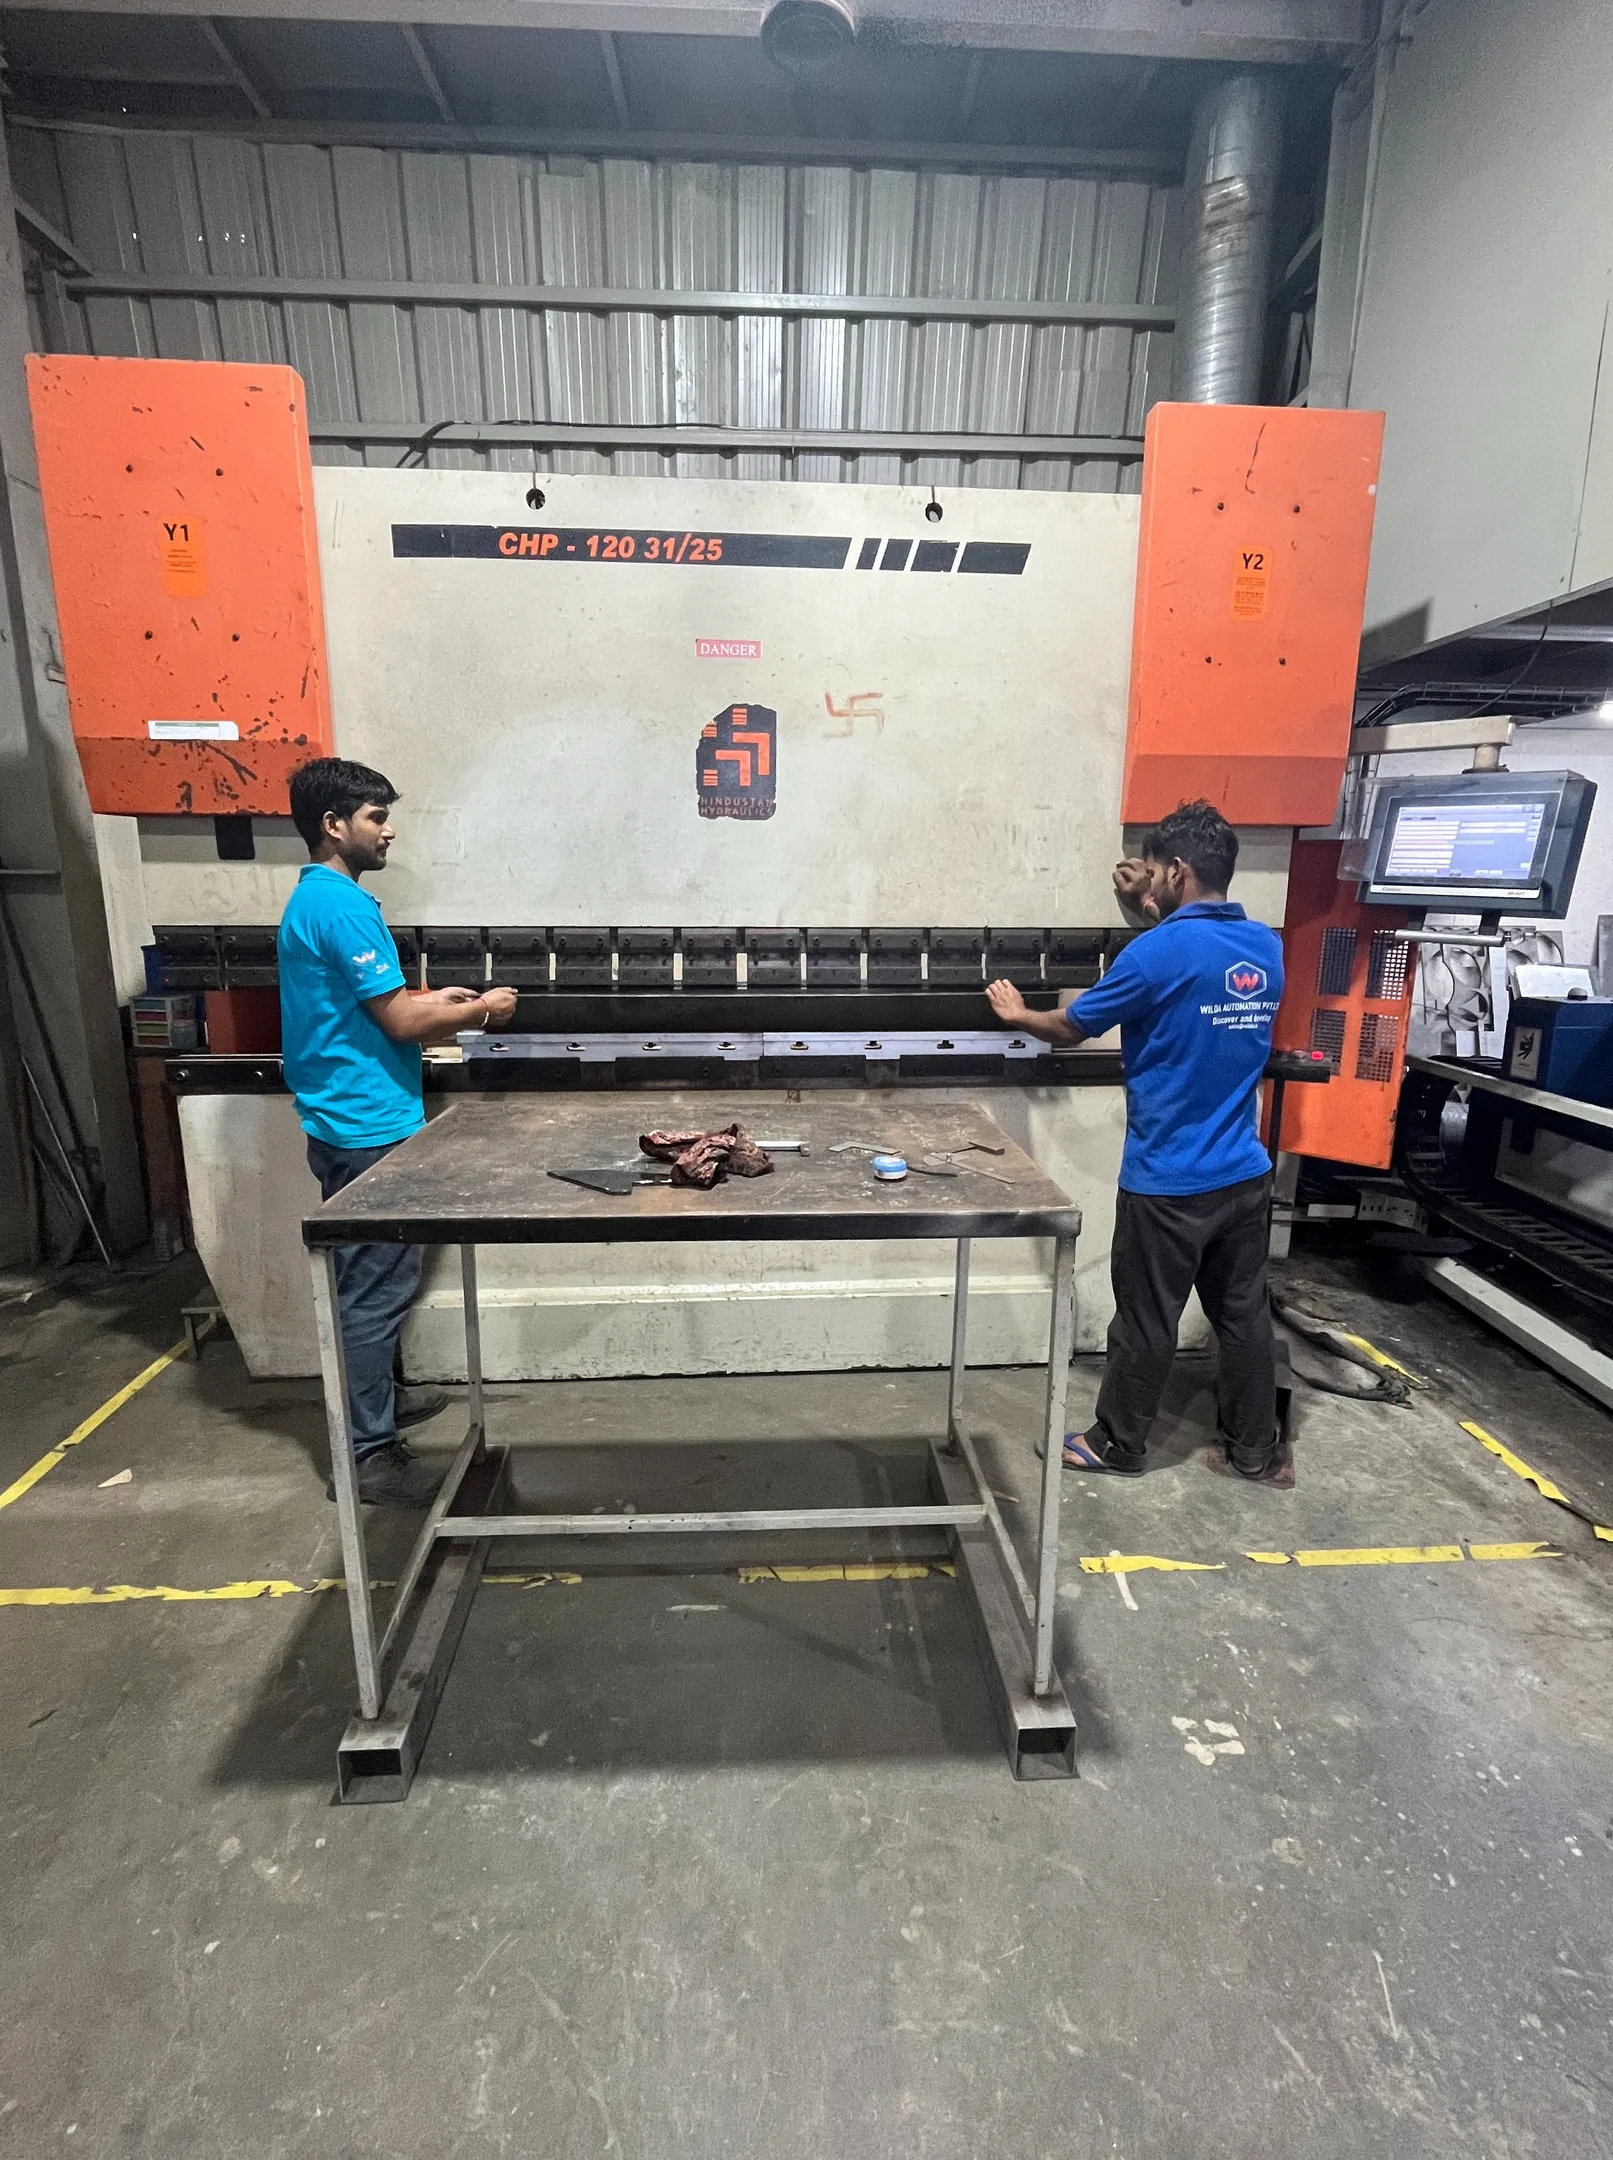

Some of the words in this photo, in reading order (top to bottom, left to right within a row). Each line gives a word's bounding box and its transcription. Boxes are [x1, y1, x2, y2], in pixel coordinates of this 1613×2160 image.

[163, 523, 189, 541] Y1
[499, 532, 559, 556] CHP
[586, 535, 636, 559] 120
[643, 533, 723, 563] 31/25
[1242, 553, 1264, 570] Y2
[700, 642, 757, 657] DANGER
[700, 806, 774, 816] HYDRAULICS
[1239, 1014, 1253, 1023] and
